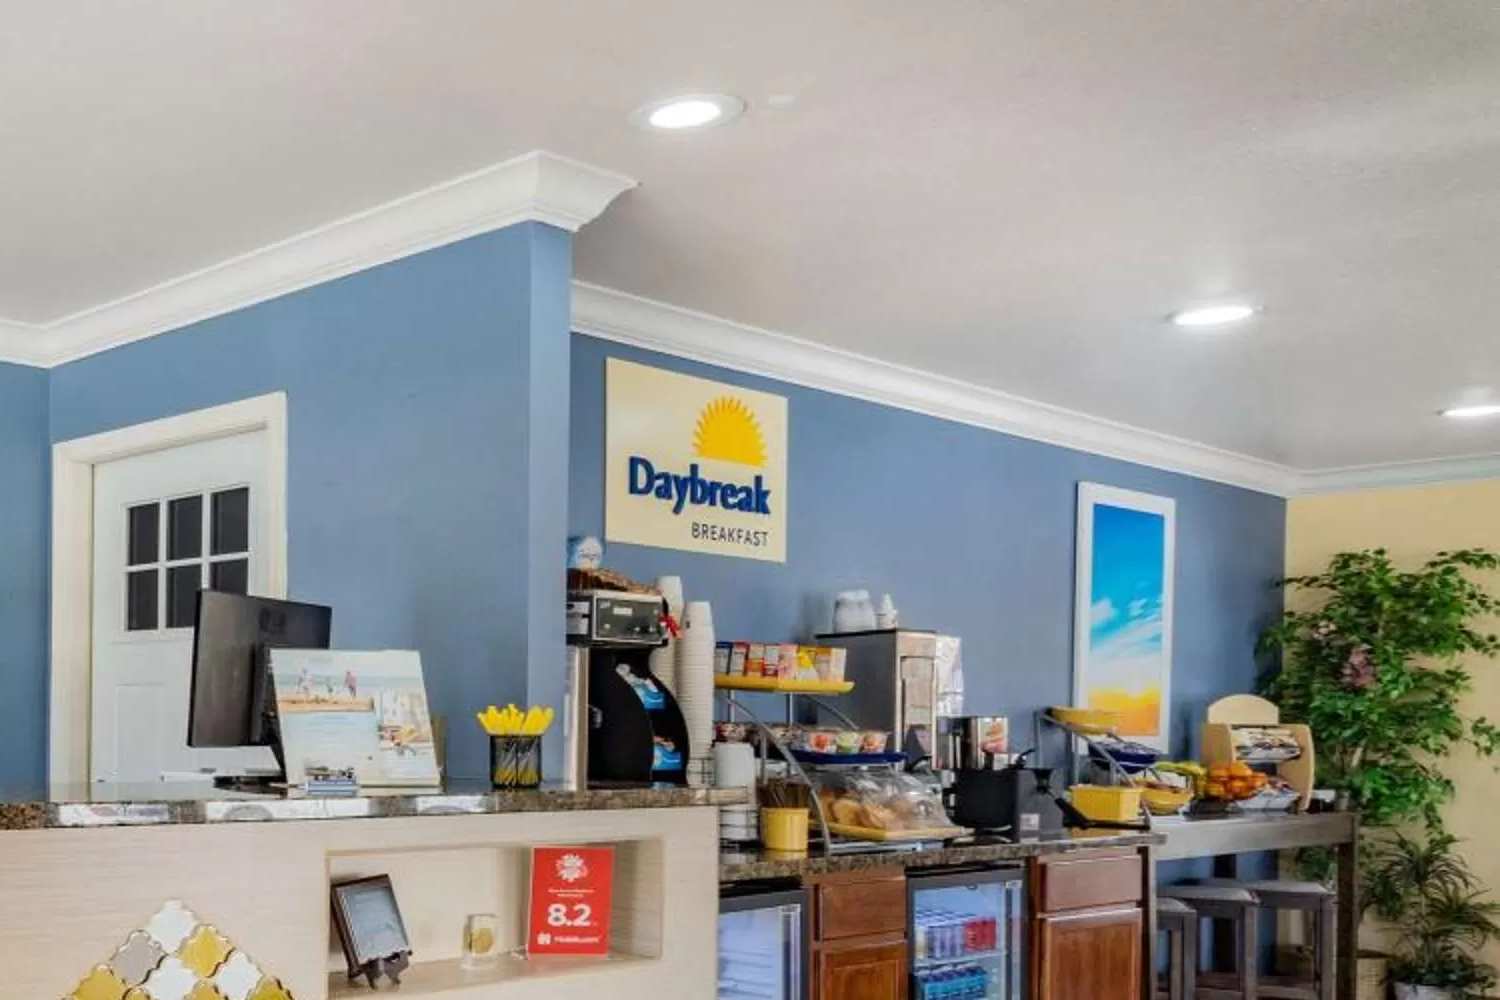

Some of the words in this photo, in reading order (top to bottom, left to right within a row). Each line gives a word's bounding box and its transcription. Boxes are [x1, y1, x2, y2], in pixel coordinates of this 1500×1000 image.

[629, 456, 771, 515] Daybreak
[691, 522, 768, 547] BREAKFAST
[547, 903, 592, 927] 8.2
